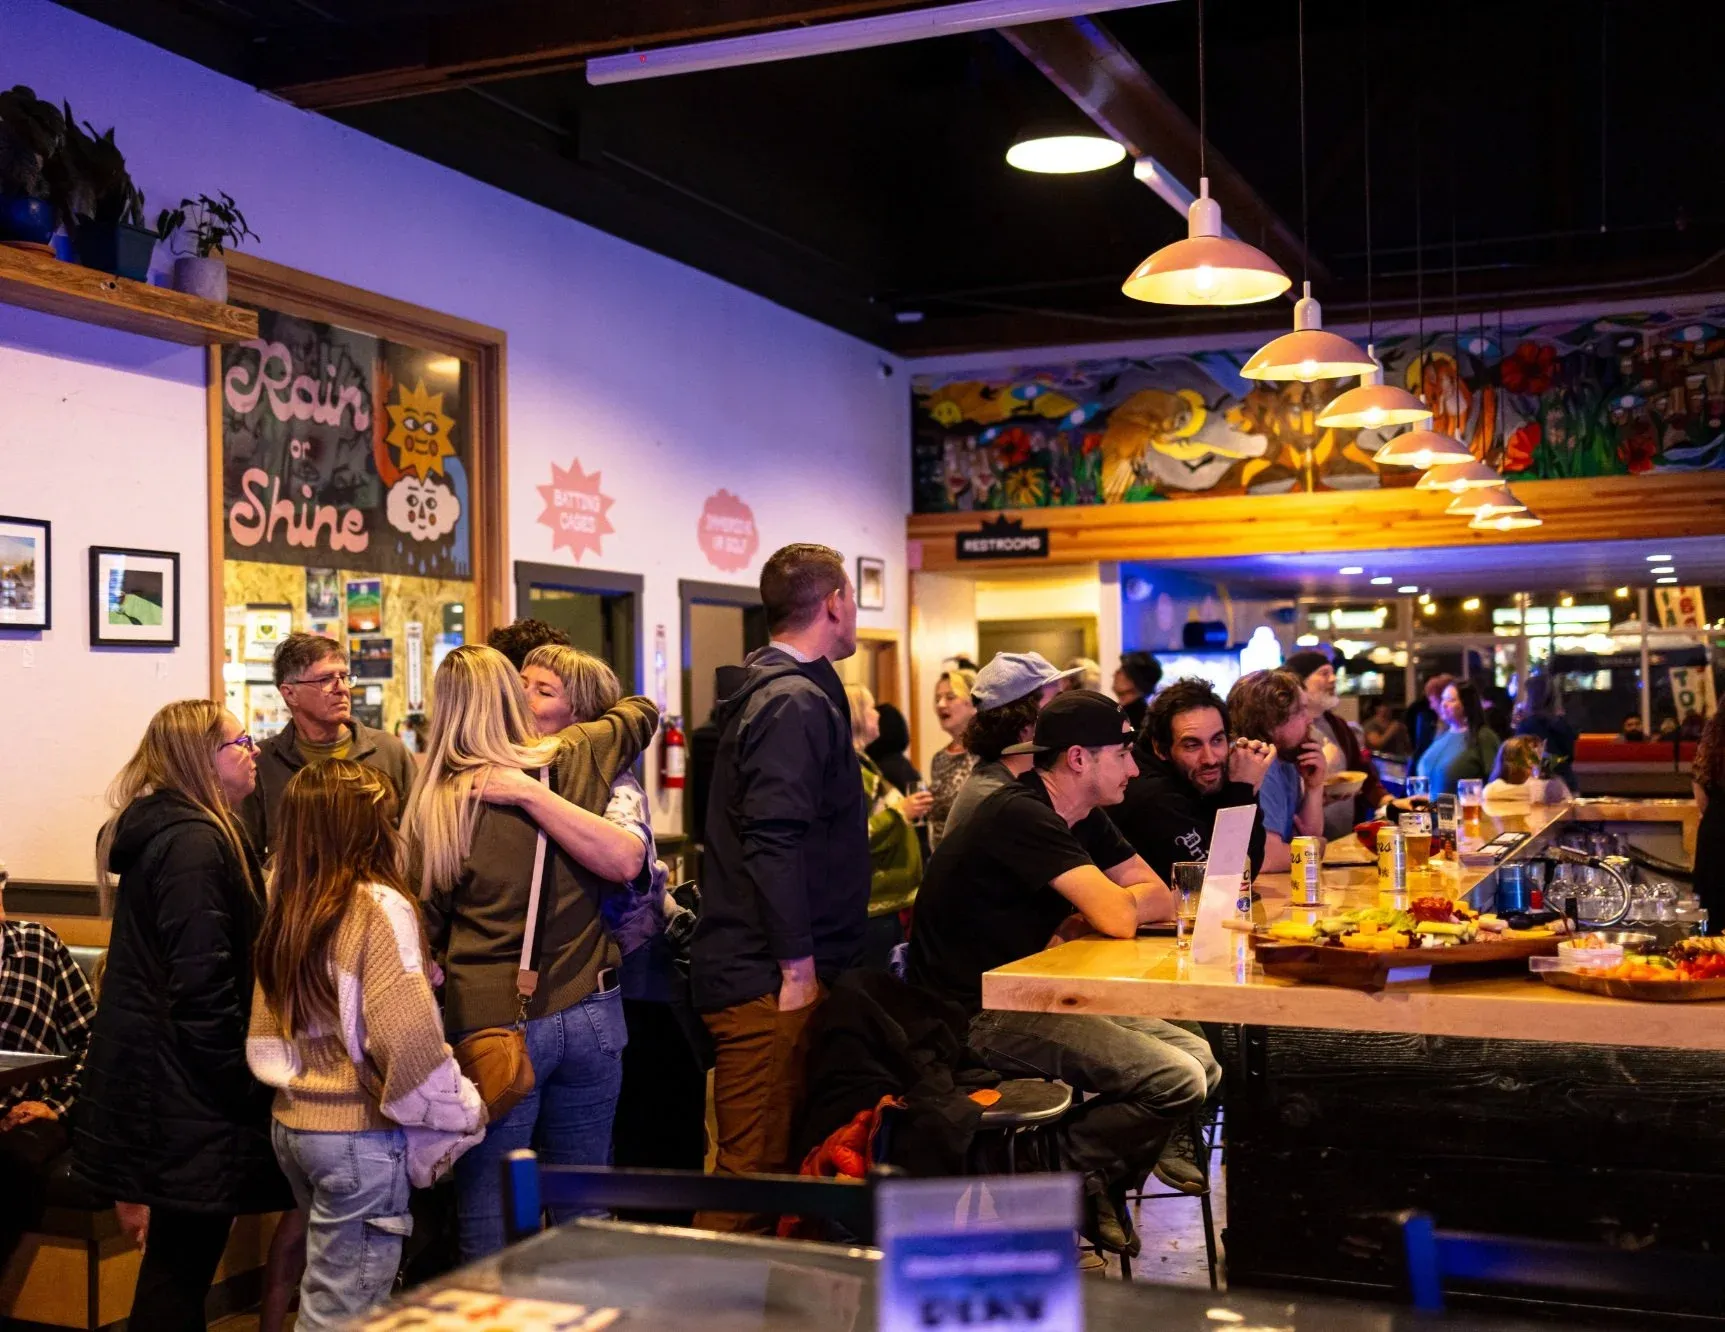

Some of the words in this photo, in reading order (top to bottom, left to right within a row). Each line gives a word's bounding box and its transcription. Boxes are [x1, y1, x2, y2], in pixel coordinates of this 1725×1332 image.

[225, 338, 369, 431] Rain
[290, 439, 311, 459] or
[229, 467, 369, 553] Shine
[963, 535, 1041, 552] RESTROOMS
